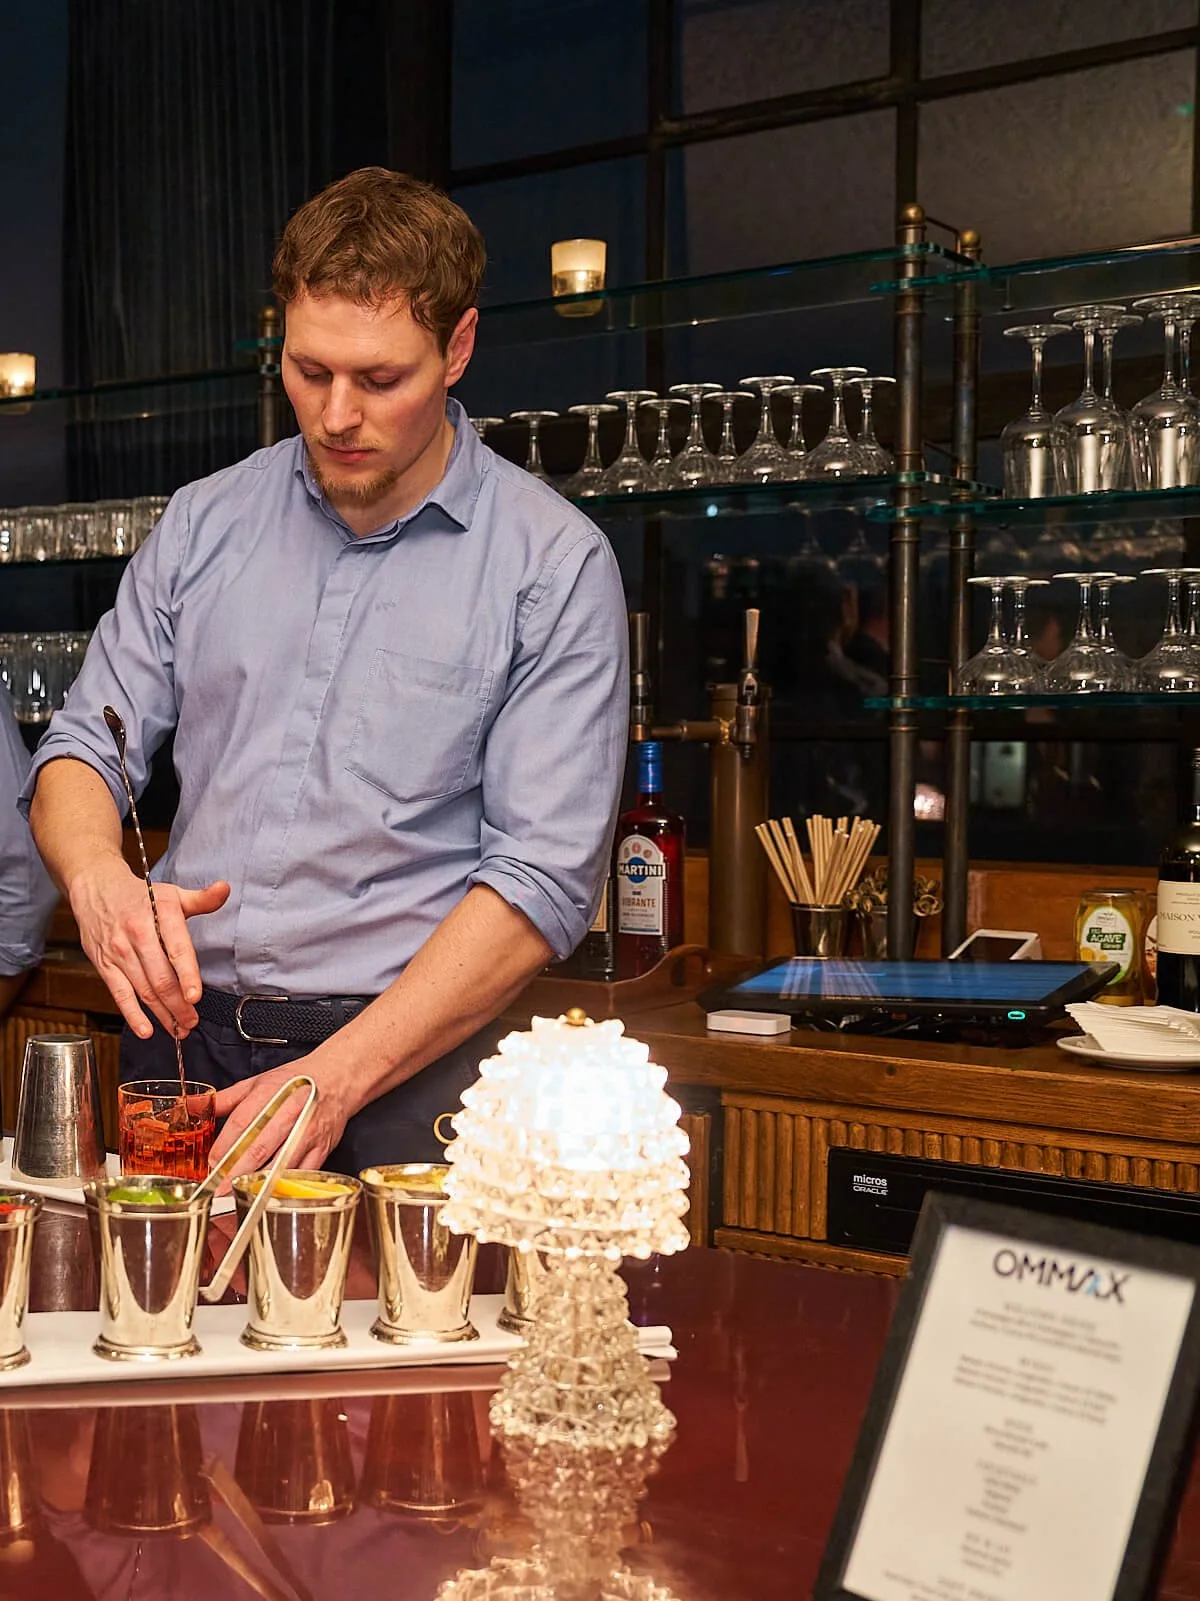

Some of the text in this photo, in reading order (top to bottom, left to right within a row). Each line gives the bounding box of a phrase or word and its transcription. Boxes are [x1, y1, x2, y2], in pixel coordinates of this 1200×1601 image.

[619, 864, 662, 876] MARTINI
[1159, 911, 1196, 921] MAISON
[1090, 934, 1122, 943] AGAVE
[853, 1174, 888, 1187] micros
[852, 1185, 889, 1196] ORACLE
[992, 1249, 1129, 1304] OMMAX
